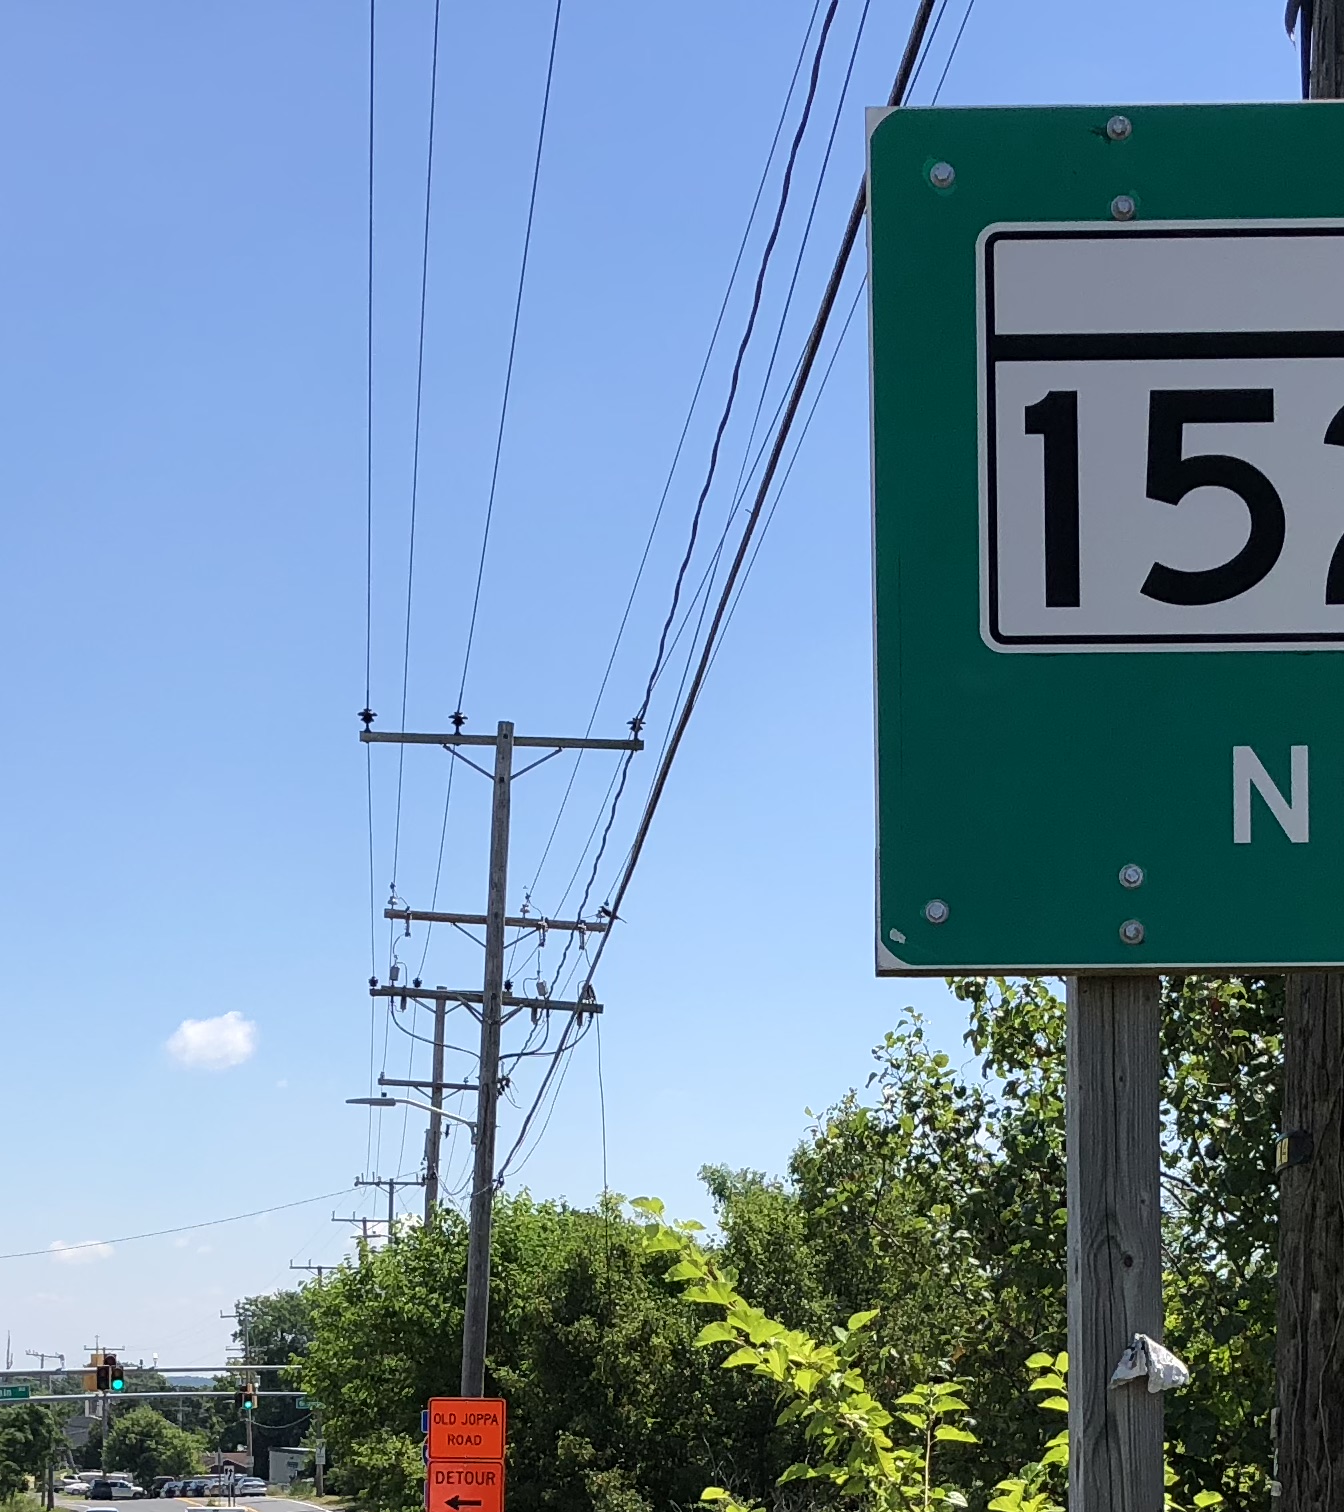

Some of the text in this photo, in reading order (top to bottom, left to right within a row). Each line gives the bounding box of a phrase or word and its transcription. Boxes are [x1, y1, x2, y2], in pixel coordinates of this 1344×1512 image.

[434, 1413, 499, 1426] OLD JOPPA
[447, 1434, 482, 1446] ROAD
[435, 1471, 496, 1486] DETOUR
